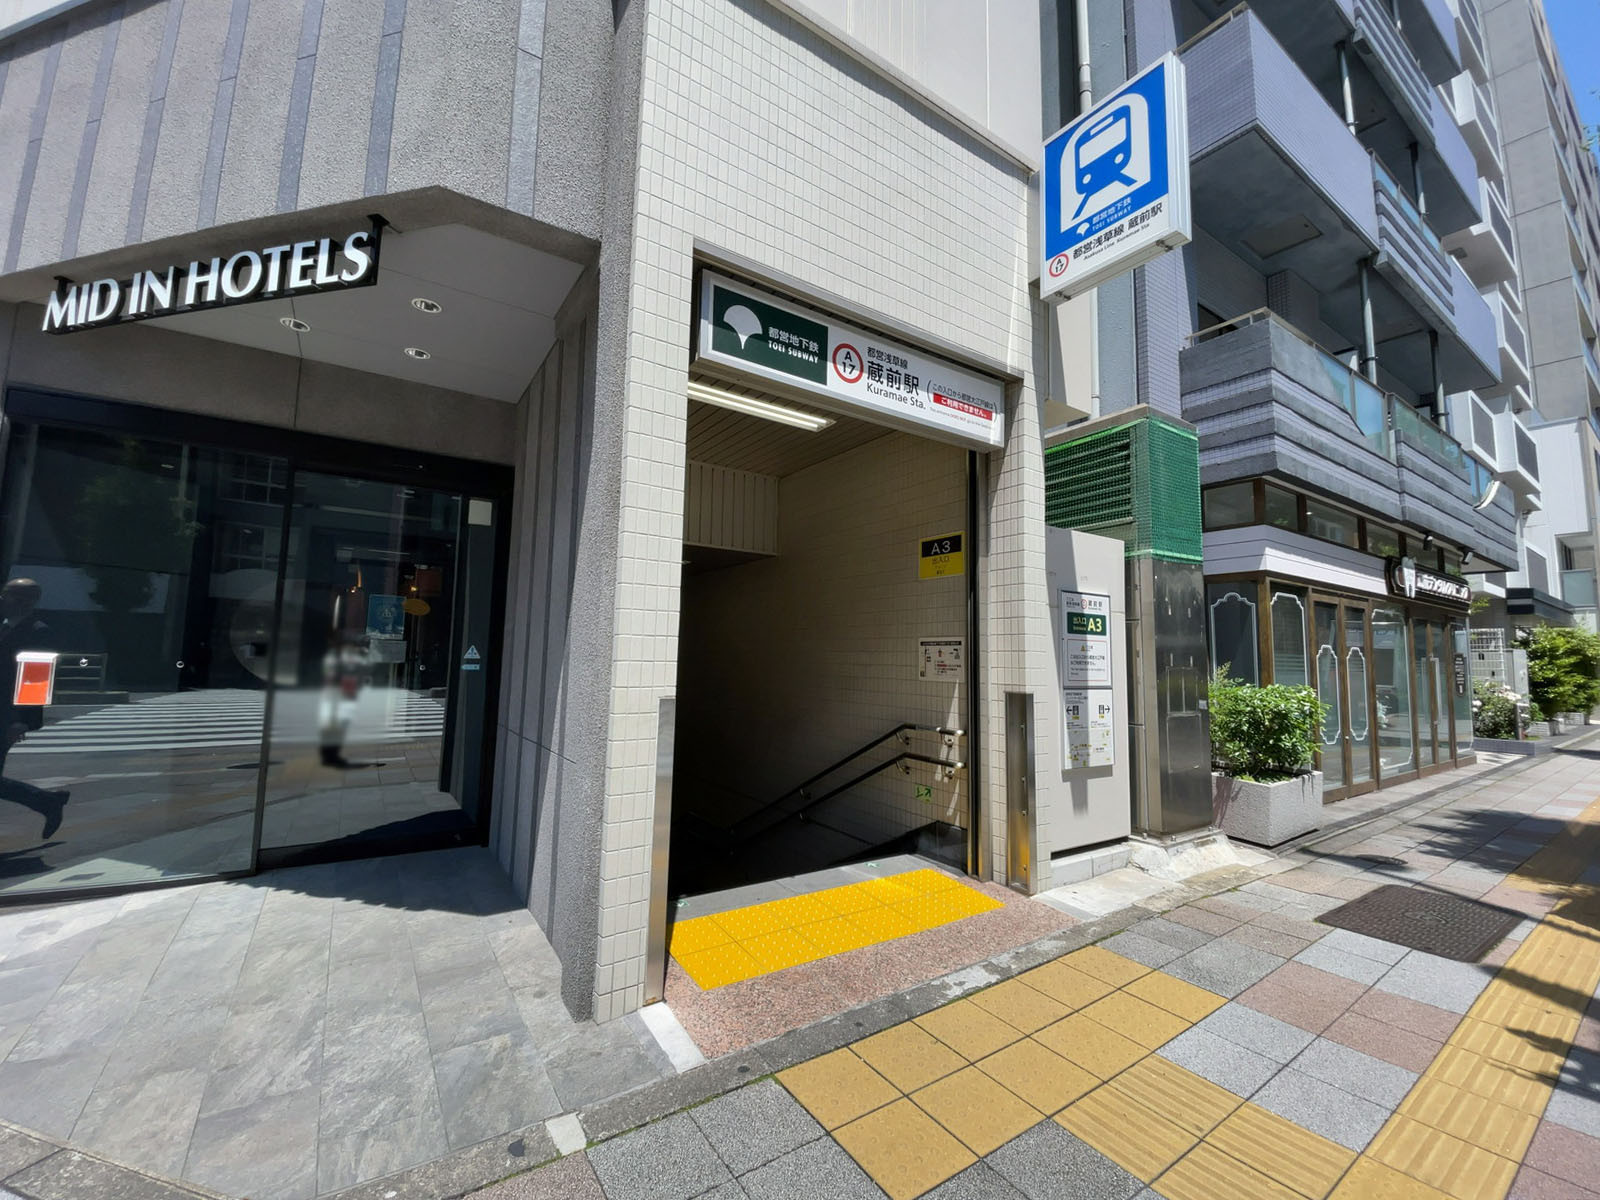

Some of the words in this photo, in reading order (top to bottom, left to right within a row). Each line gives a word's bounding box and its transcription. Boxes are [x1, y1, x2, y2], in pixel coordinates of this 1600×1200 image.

[1072, 224, 1125, 260] 都営浅草線
[1127, 202, 1163, 230] 蔵前駅
[1055, 263, 1064, 273] 17
[42, 278, 120, 331] MID
[129, 265, 176, 315] IN
[184, 231, 370, 305] HOTELS
[768, 326, 819, 354] 都営地下鉄
[768, 340, 786, 352] TOEI
[788, 347, 819, 364] SUBWAY
[844, 351, 853, 362] A
[867, 347, 909, 370] 都営浅草線
[842, 361, 856, 375] 17
[867, 360, 920, 396] 蔵前駅
[867, 382, 908, 404] Kuramae
[910, 396, 926, 410] Sta.
[931, 540, 951, 555] A3
[1087, 617, 1102, 632] A3
